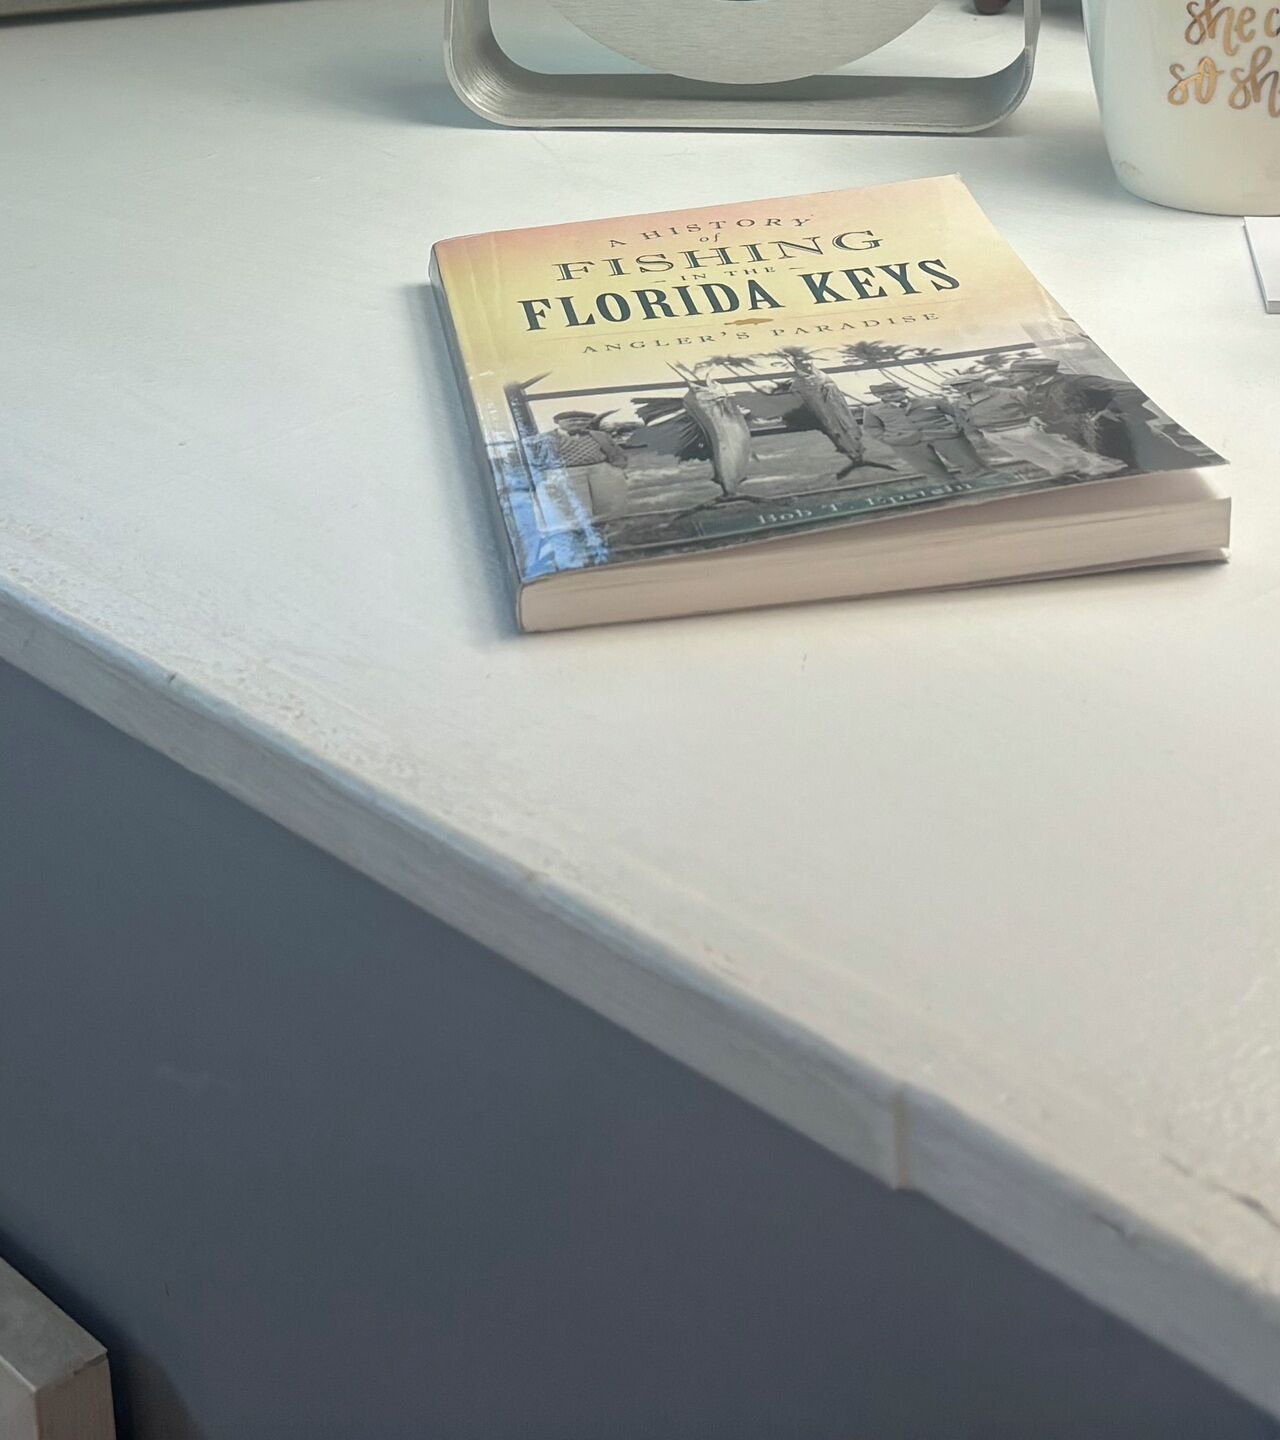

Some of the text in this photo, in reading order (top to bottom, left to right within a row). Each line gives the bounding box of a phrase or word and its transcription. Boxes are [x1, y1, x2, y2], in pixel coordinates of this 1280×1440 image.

[1167, 56, 1224, 105] so
[608, 216, 812, 249] A HISTORY
[699, 232, 720, 243] of
[556, 229, 885, 282] FISHING
[680, 266, 776, 283] IN THE
[517, 258, 962, 332] FLORIDA KEYS
[583, 313, 941, 354] ANGLER'S PARADISE
